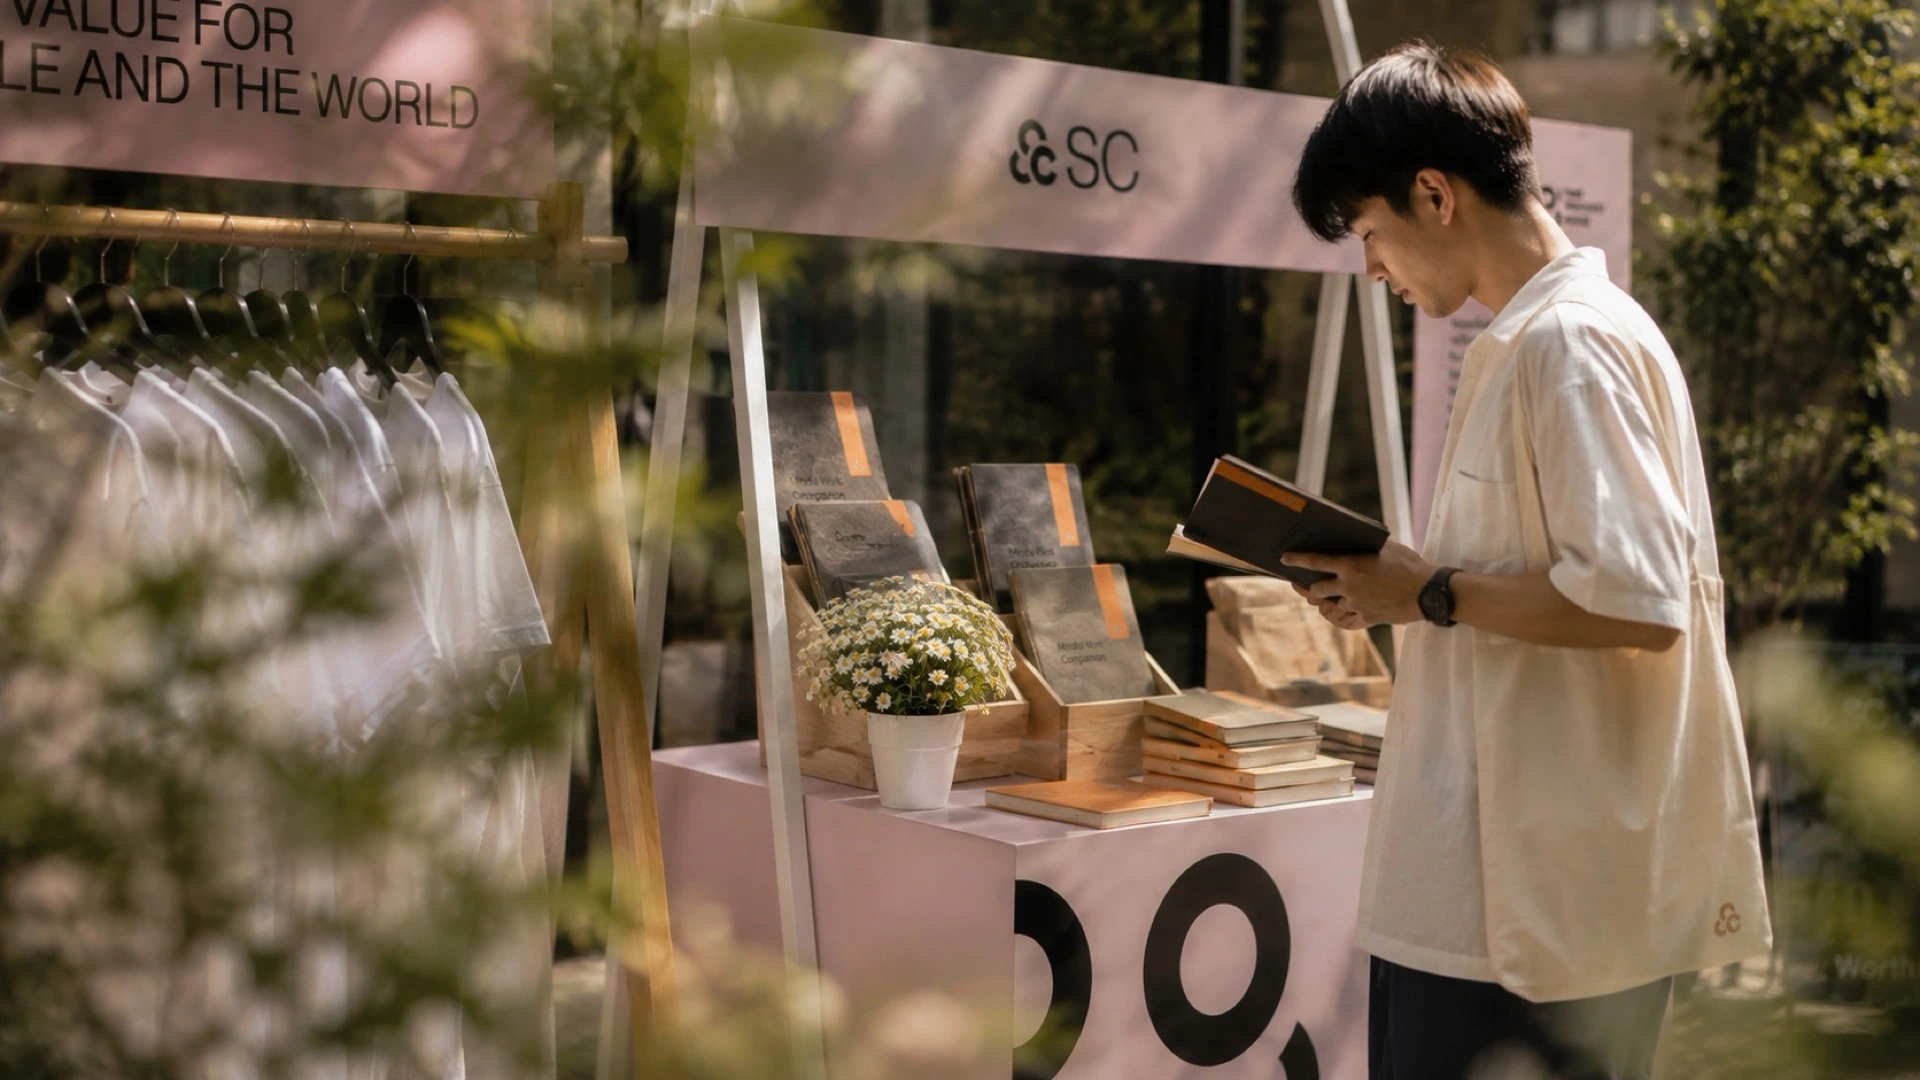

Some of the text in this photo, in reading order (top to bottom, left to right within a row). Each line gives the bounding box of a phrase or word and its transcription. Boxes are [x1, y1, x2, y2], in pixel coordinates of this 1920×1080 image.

[13, 0, 294, 56] VALUE FOR
[0, 40, 480, 130] LE AND THE WORLD
